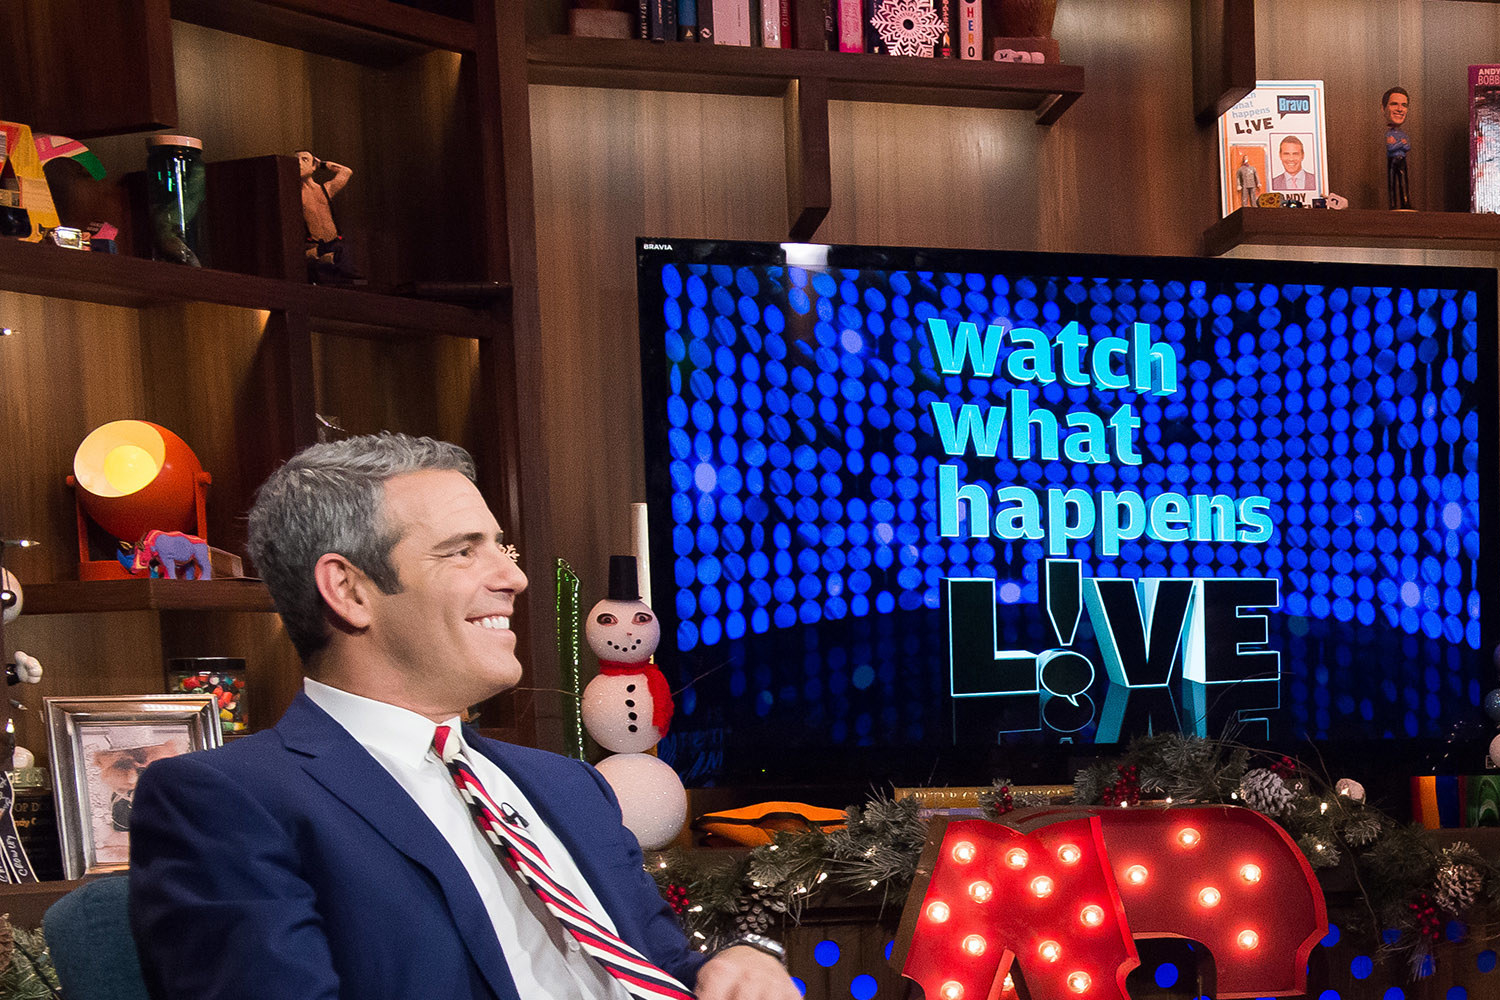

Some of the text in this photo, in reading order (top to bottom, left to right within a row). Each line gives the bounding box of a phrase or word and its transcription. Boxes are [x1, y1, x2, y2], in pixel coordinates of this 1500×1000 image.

[1278, 97, 1309, 111] Bravo
[1231, 106, 1271, 119] happens
[643, 243, 673, 251] BRAVIA
[930, 388, 1144, 467] what
[937, 463, 1275, 557] happens
